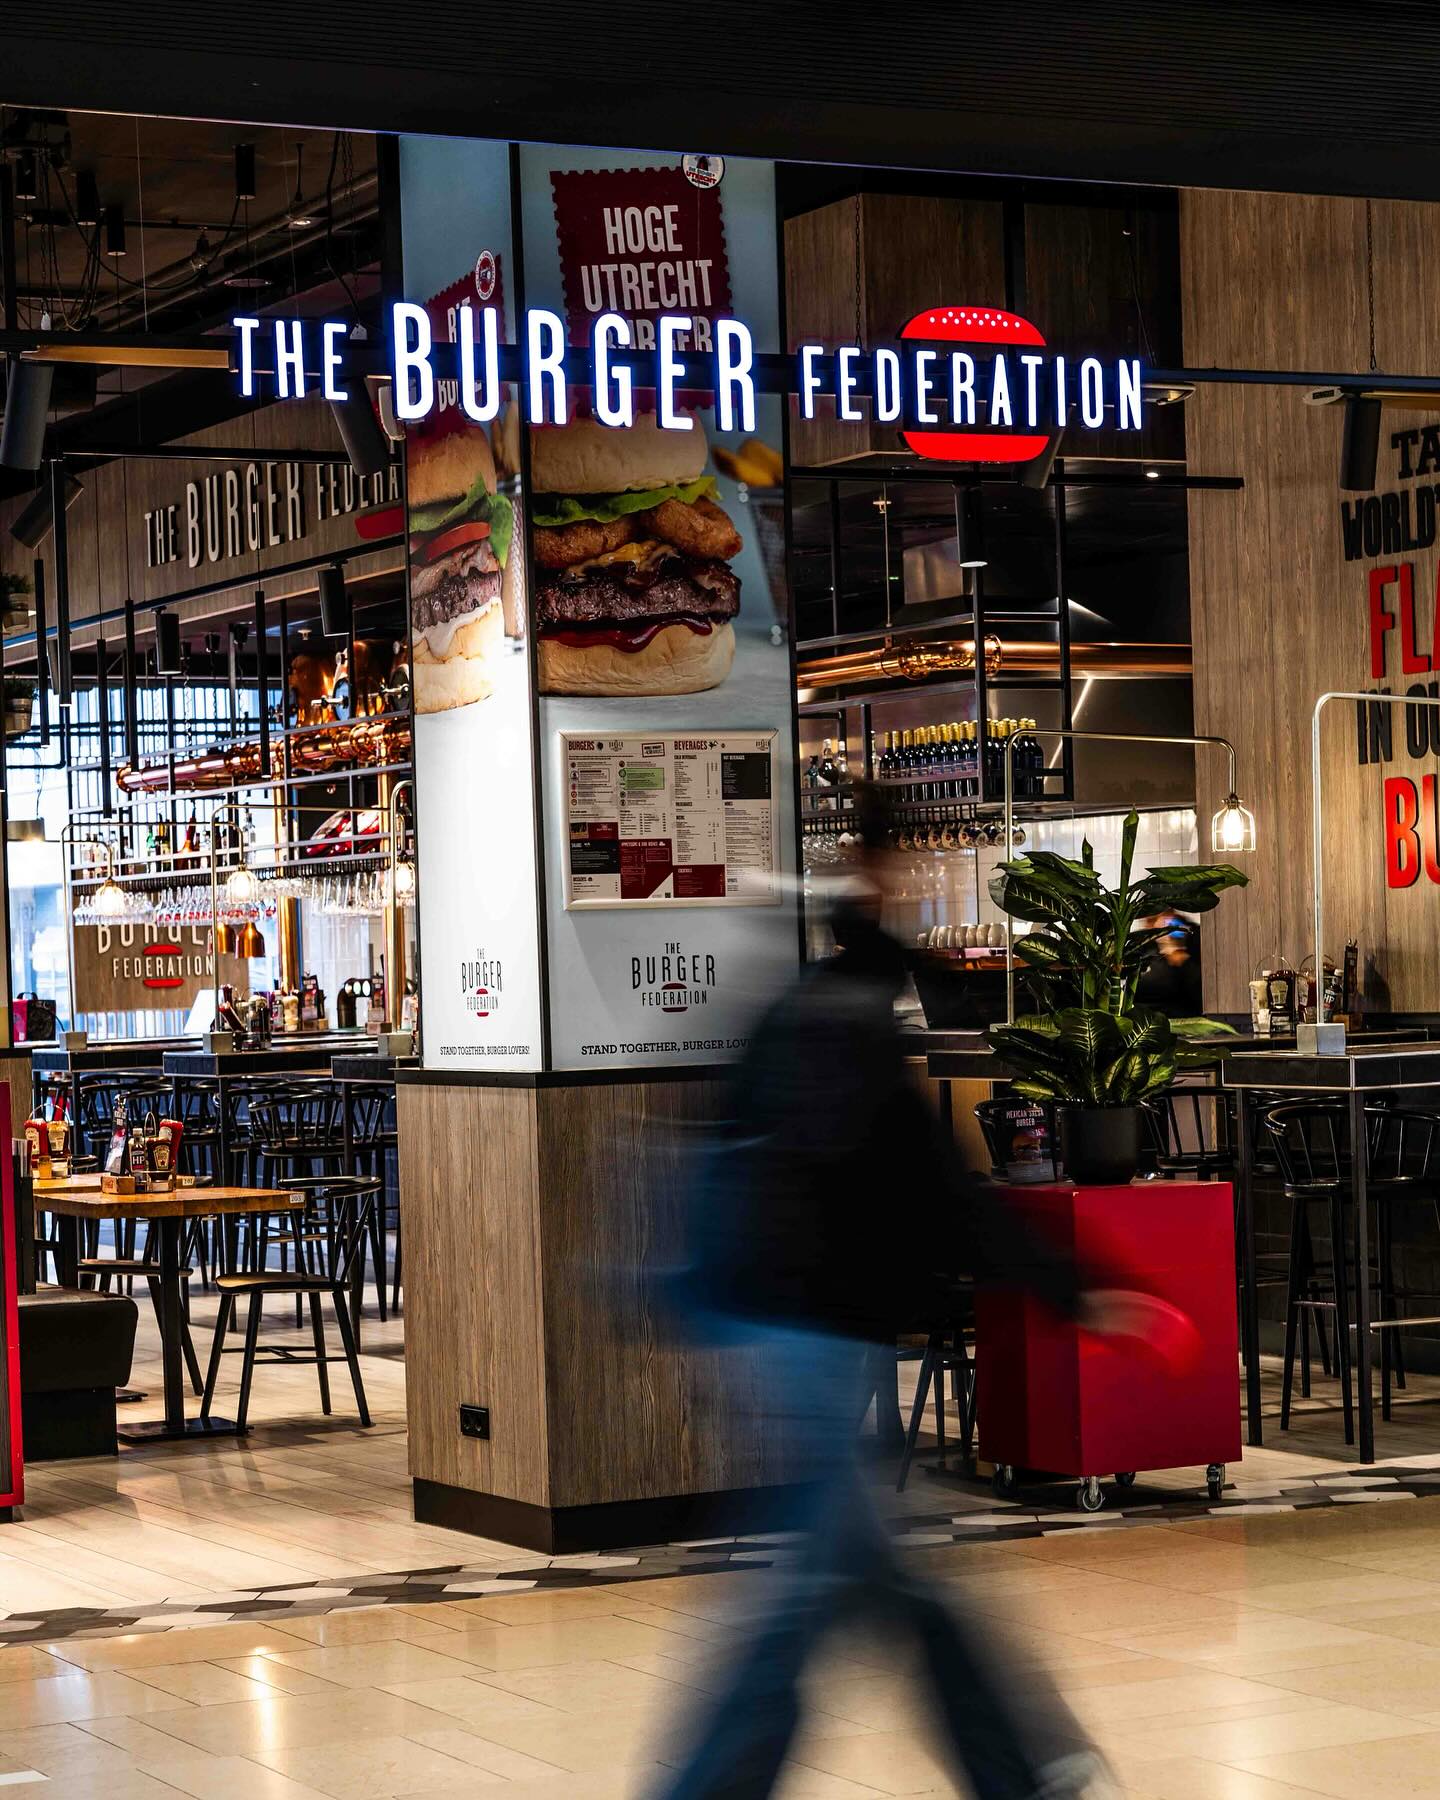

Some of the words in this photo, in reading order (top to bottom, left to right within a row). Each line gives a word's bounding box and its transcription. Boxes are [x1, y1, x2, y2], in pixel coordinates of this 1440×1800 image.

[603, 205, 683, 255] HOGE
[581, 259, 713, 312] UTRECHT
[233, 317, 349, 400] THE
[393, 302, 756, 432] BURGER
[802, 345, 1143, 430] FEDERATION
[144, 504, 177, 567] THE
[187, 462, 302, 568] BURGER
[1369, 559, 1440, 679] FL
[1356, 687, 1393, 765] IN
[568, 741, 595, 751] BURGERS
[674, 740, 708, 751] BEVERAGES
[476, 948, 485, 960] THE
[665, 943, 681, 954] THE
[112, 955, 214, 979] FEDERATION
[631, 954, 716, 990] BURGER
[461, 960, 503, 994] BURGER
[466, 996, 499, 1011] FEDERATION
[642, 990, 708, 1007] FEDERATION
[1323, 993, 1335, 1003] HP
[440, 1046, 457, 1055] STAND
[458, 1046, 487, 1056] TOGETHER,
[487, 1046, 508, 1055] BURGER
[508, 1045, 530, 1055] LOVERS!
[581, 1045, 618, 1056] STAND
[619, 1041, 681, 1054] TOGETHER,
[683, 1040, 724, 1050] BURGER
[132, 1155, 145, 1165] HP
